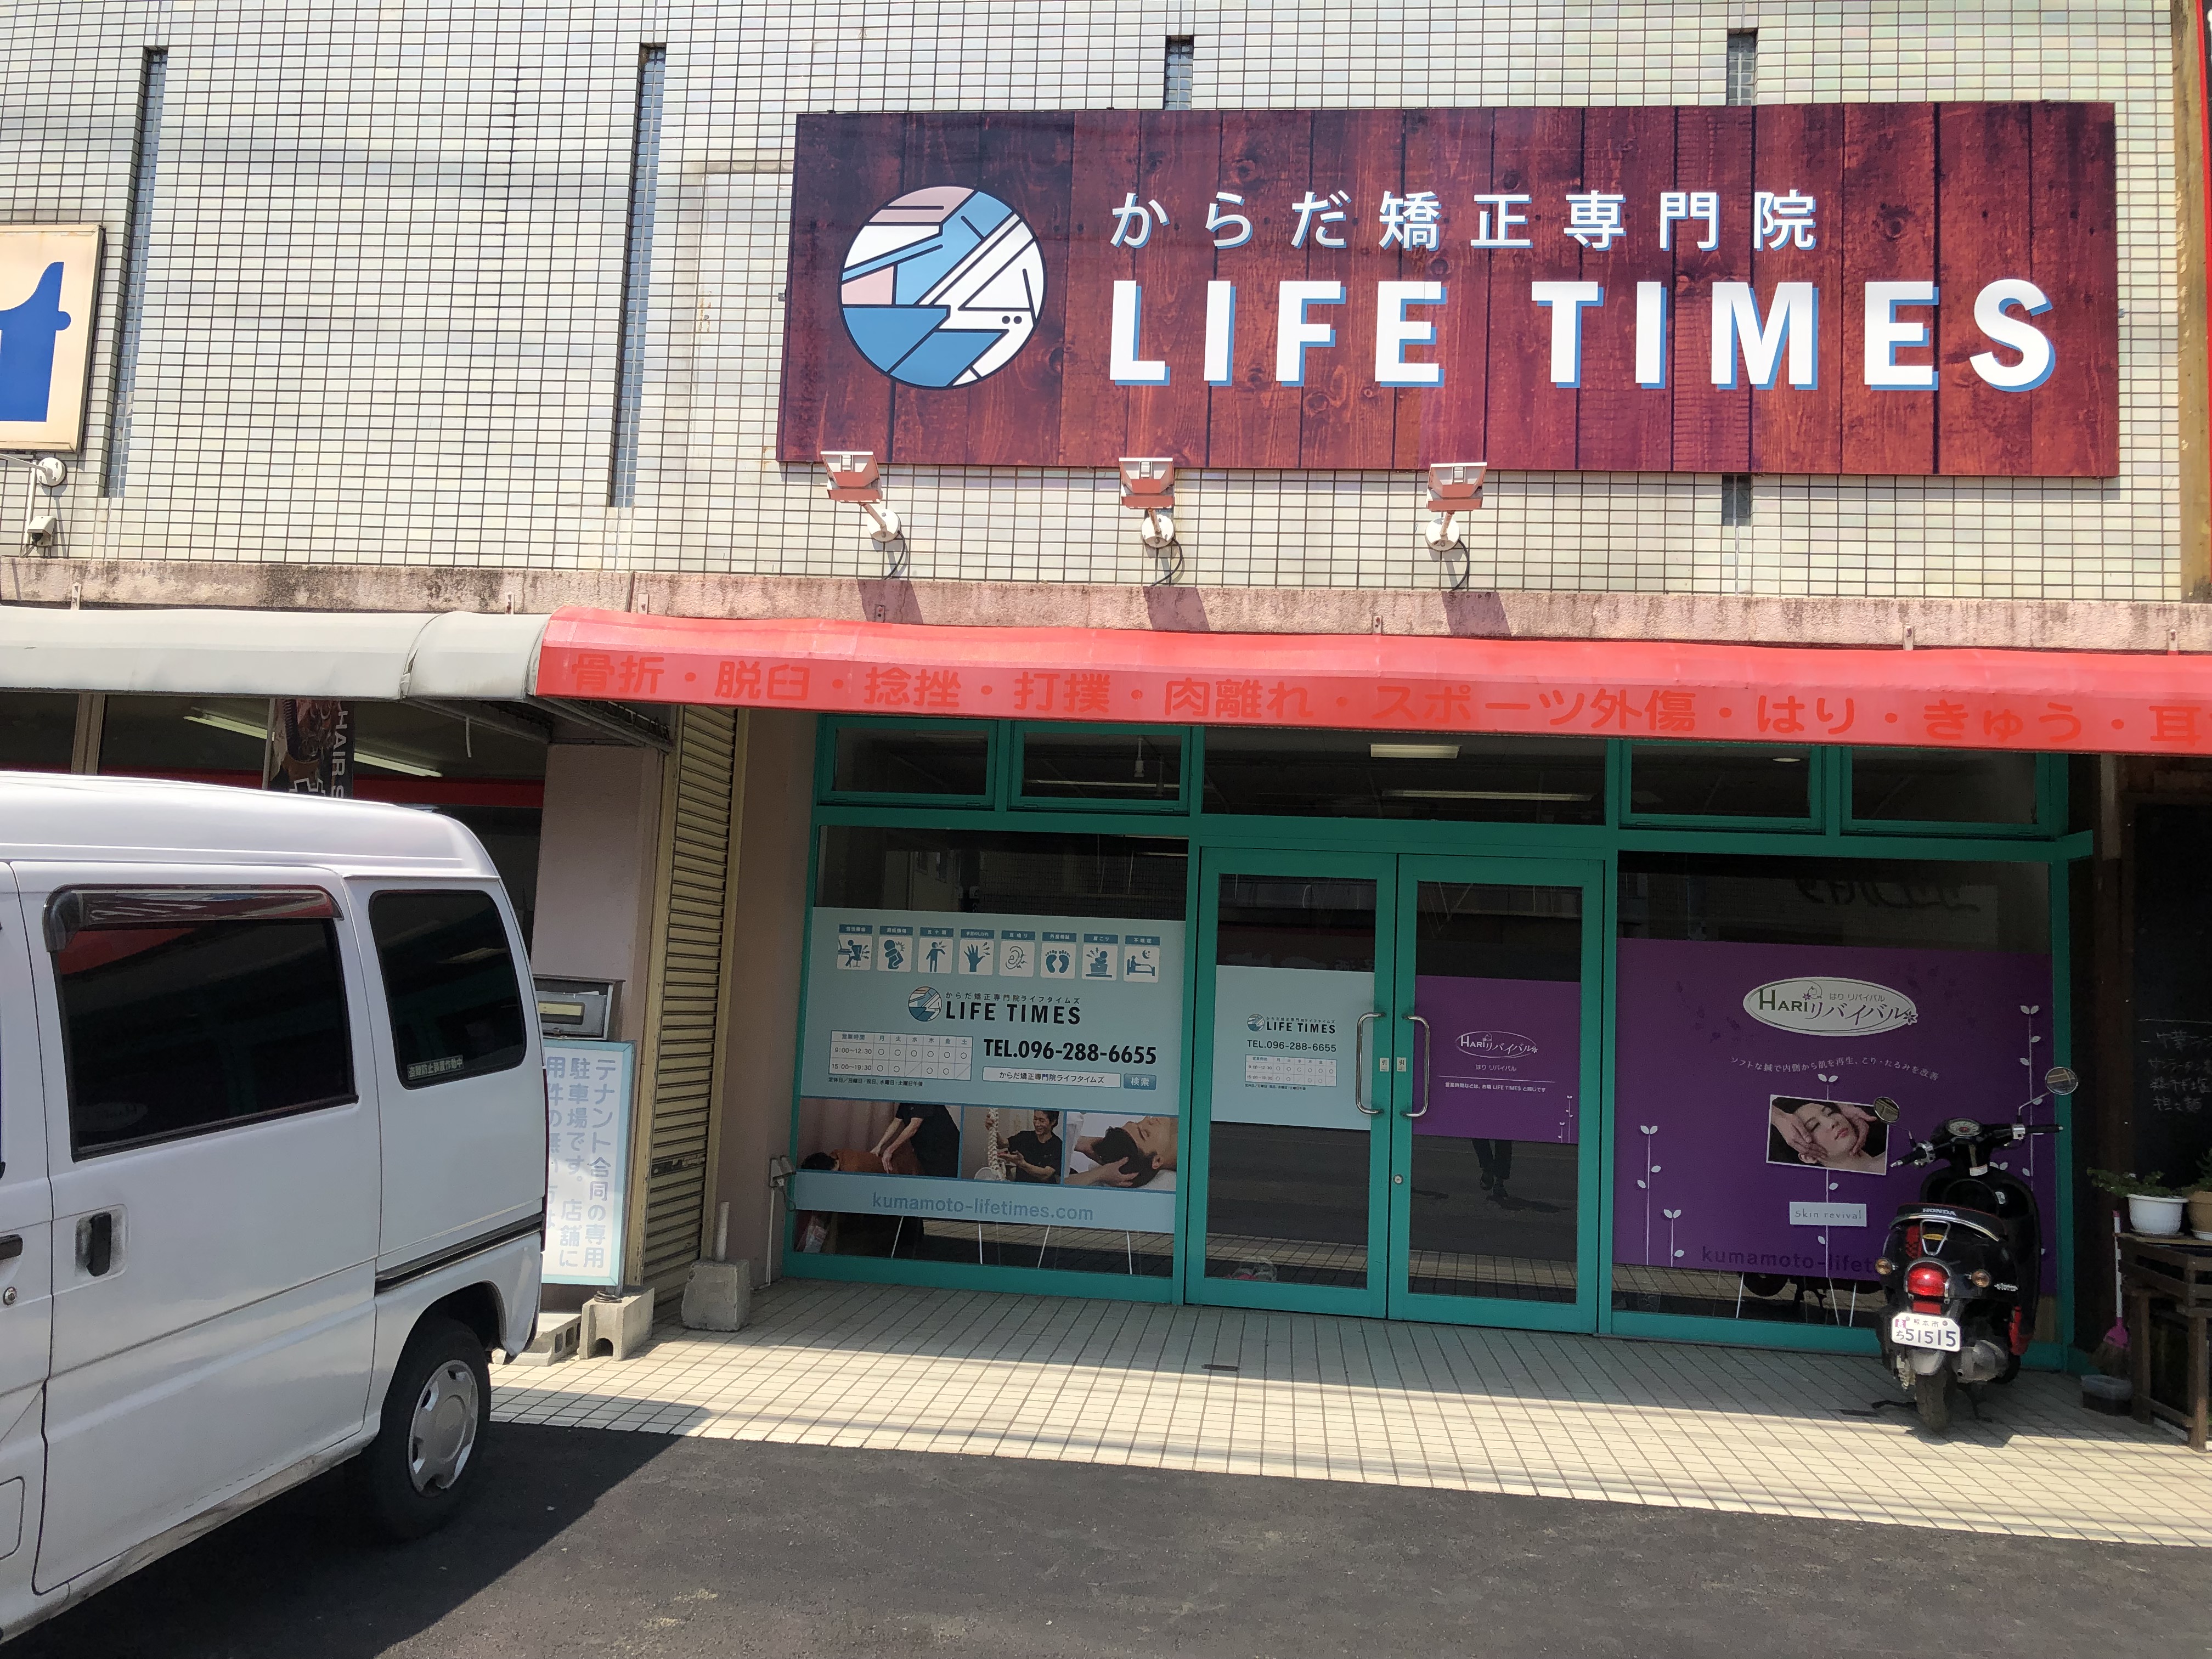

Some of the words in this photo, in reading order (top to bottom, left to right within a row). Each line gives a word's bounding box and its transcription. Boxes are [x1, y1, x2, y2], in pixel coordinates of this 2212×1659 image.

[1109, 189, 1818, 251] からだ矯正専門院
[1109, 279, 1447, 388] LIFE
[1531, 278, 2056, 393] TIMES
[331, 710, 348, 776] HAIR
[945, 991, 1080, 1005] からだ矯正専門院ライフタイムズ
[1848, 993, 1885, 1002] リバイバル
[946, 1001, 996, 1021] LIFE
[1007, 1003, 1080, 1025] TIMES
[1266, 1021, 1293, 1032] LIFE
[1298, 1022, 1336, 1034] TIMES
[983, 1038, 1156, 1065] TEL.096-288-6655
[1246, 1039, 1336, 1052] TEL.096-288-6655
[999, 1071, 1104, 1084] からだ矯正専門院ライフタイムズ
[1130, 1076, 1150, 1087] 検索
[583, 1059, 616, 1268] テナント合同の専用
[872, 1192, 1094, 1221] kumamoto-lifetimes.com
[1824, 1209, 1861, 1219] revival
[1701, 1246, 1872, 1273] kumamoto-lifet
[1914, 1318, 1939, 1328] 熊本市
